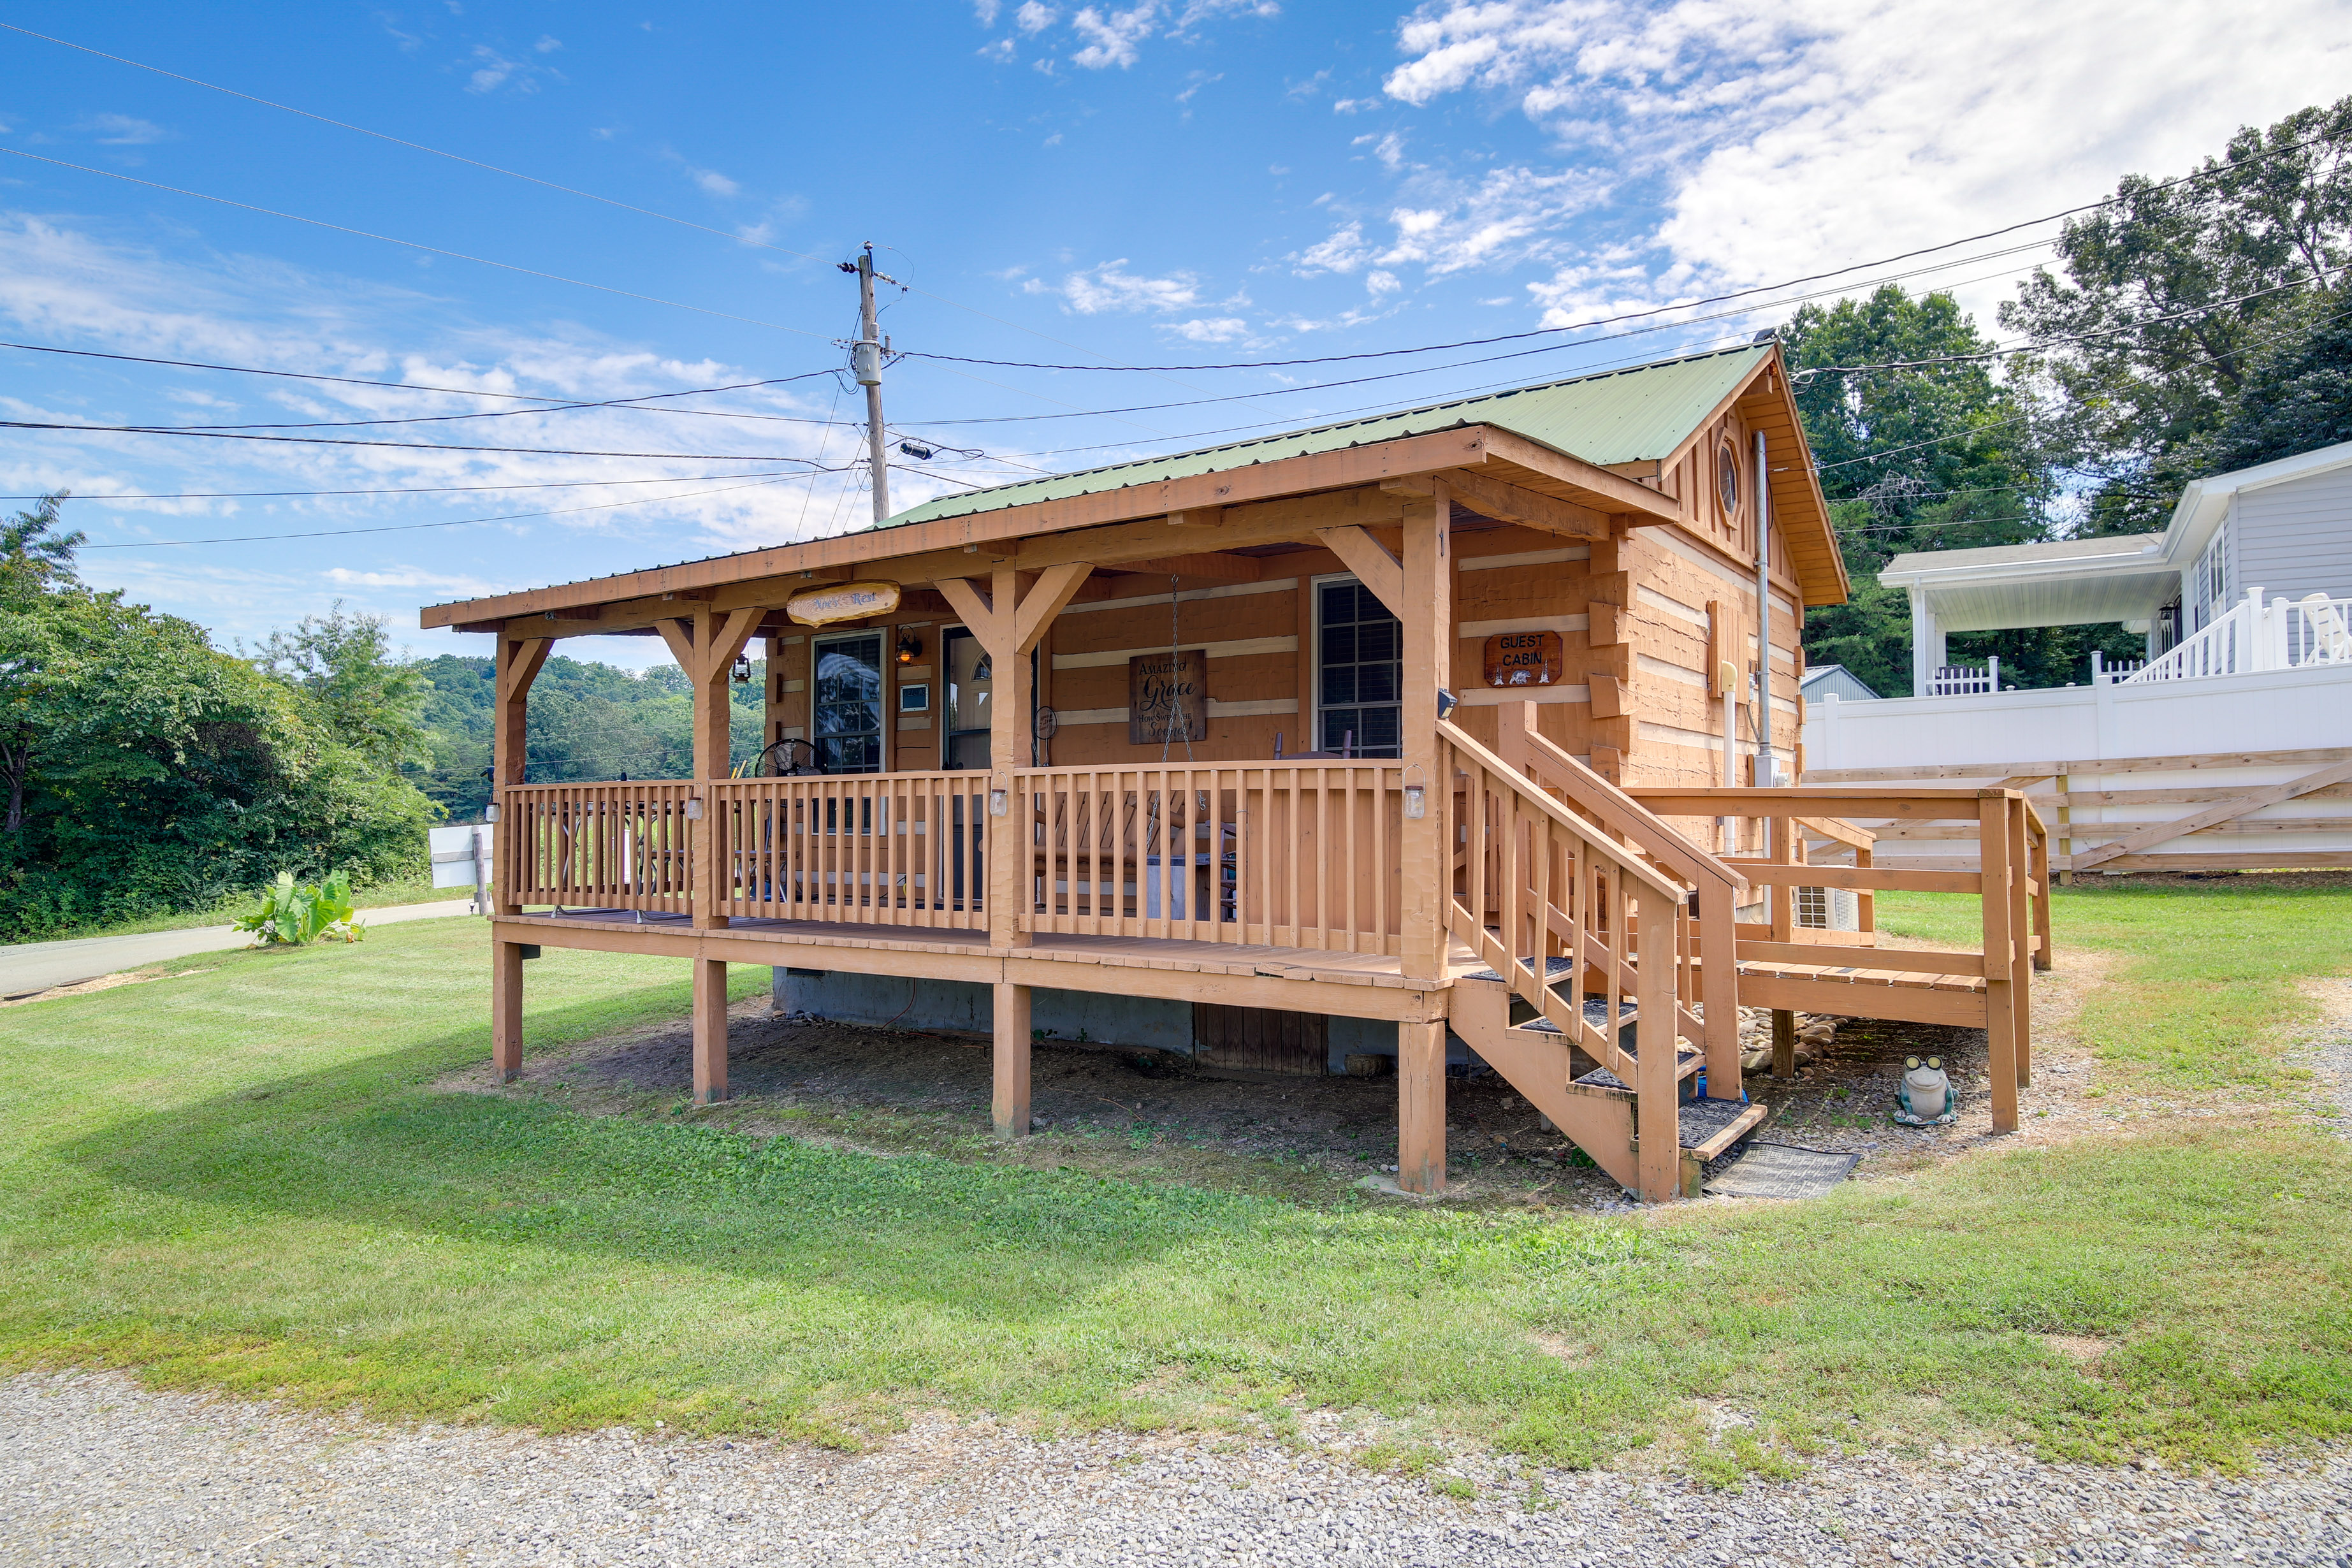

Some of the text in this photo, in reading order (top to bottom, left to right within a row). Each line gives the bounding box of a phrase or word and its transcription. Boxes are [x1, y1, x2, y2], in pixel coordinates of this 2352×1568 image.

[851, 592, 876, 605] Rest
[1500, 634, 1545, 649] GUEST
[1502, 651, 1542, 666] CABIN
[1140, 674, 1197, 711] Grace
[1156, 713, 1177, 722] SWET
